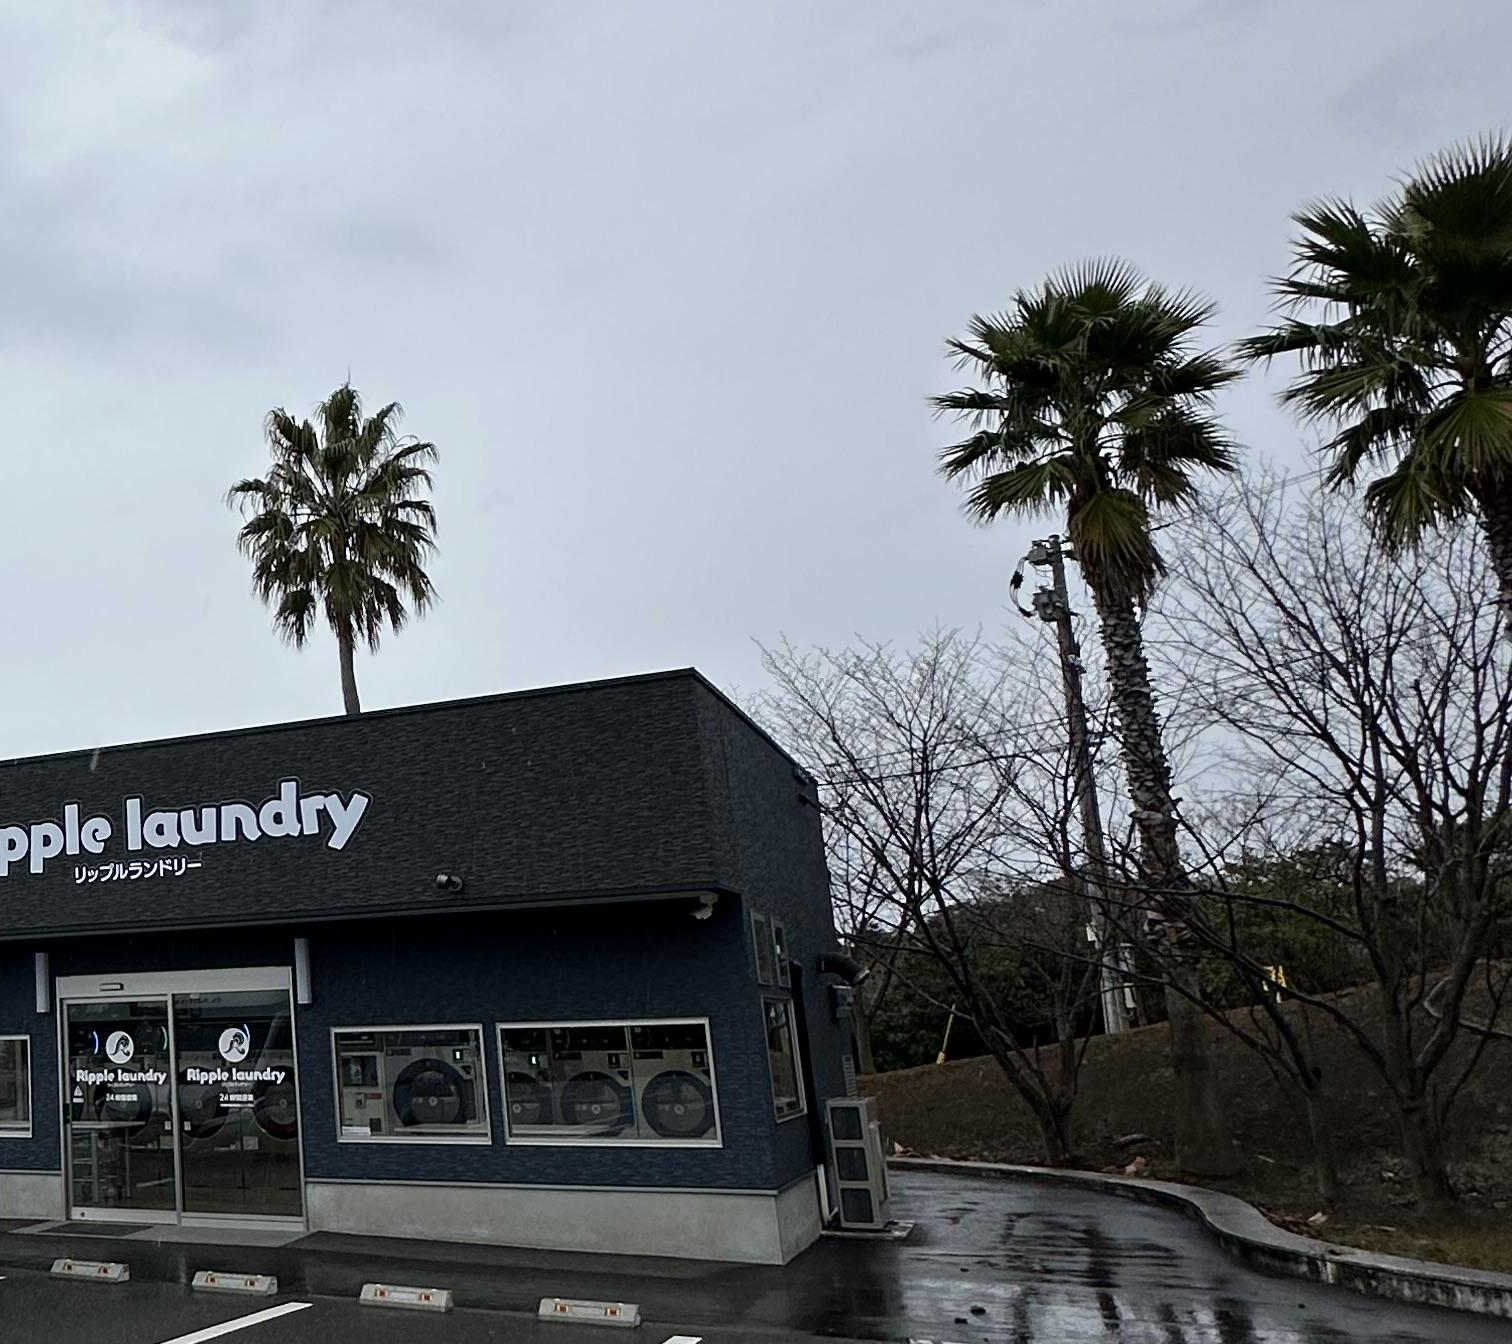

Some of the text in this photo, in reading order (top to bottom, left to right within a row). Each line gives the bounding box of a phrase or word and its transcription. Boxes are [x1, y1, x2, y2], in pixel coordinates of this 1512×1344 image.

[125, 781, 370, 850] laundry
[74, 857, 202, 884] リップルランドリー
[76, 1068, 167, 1085] Ripple laundry
[187, 1067, 286, 1085] Ripple laundry
